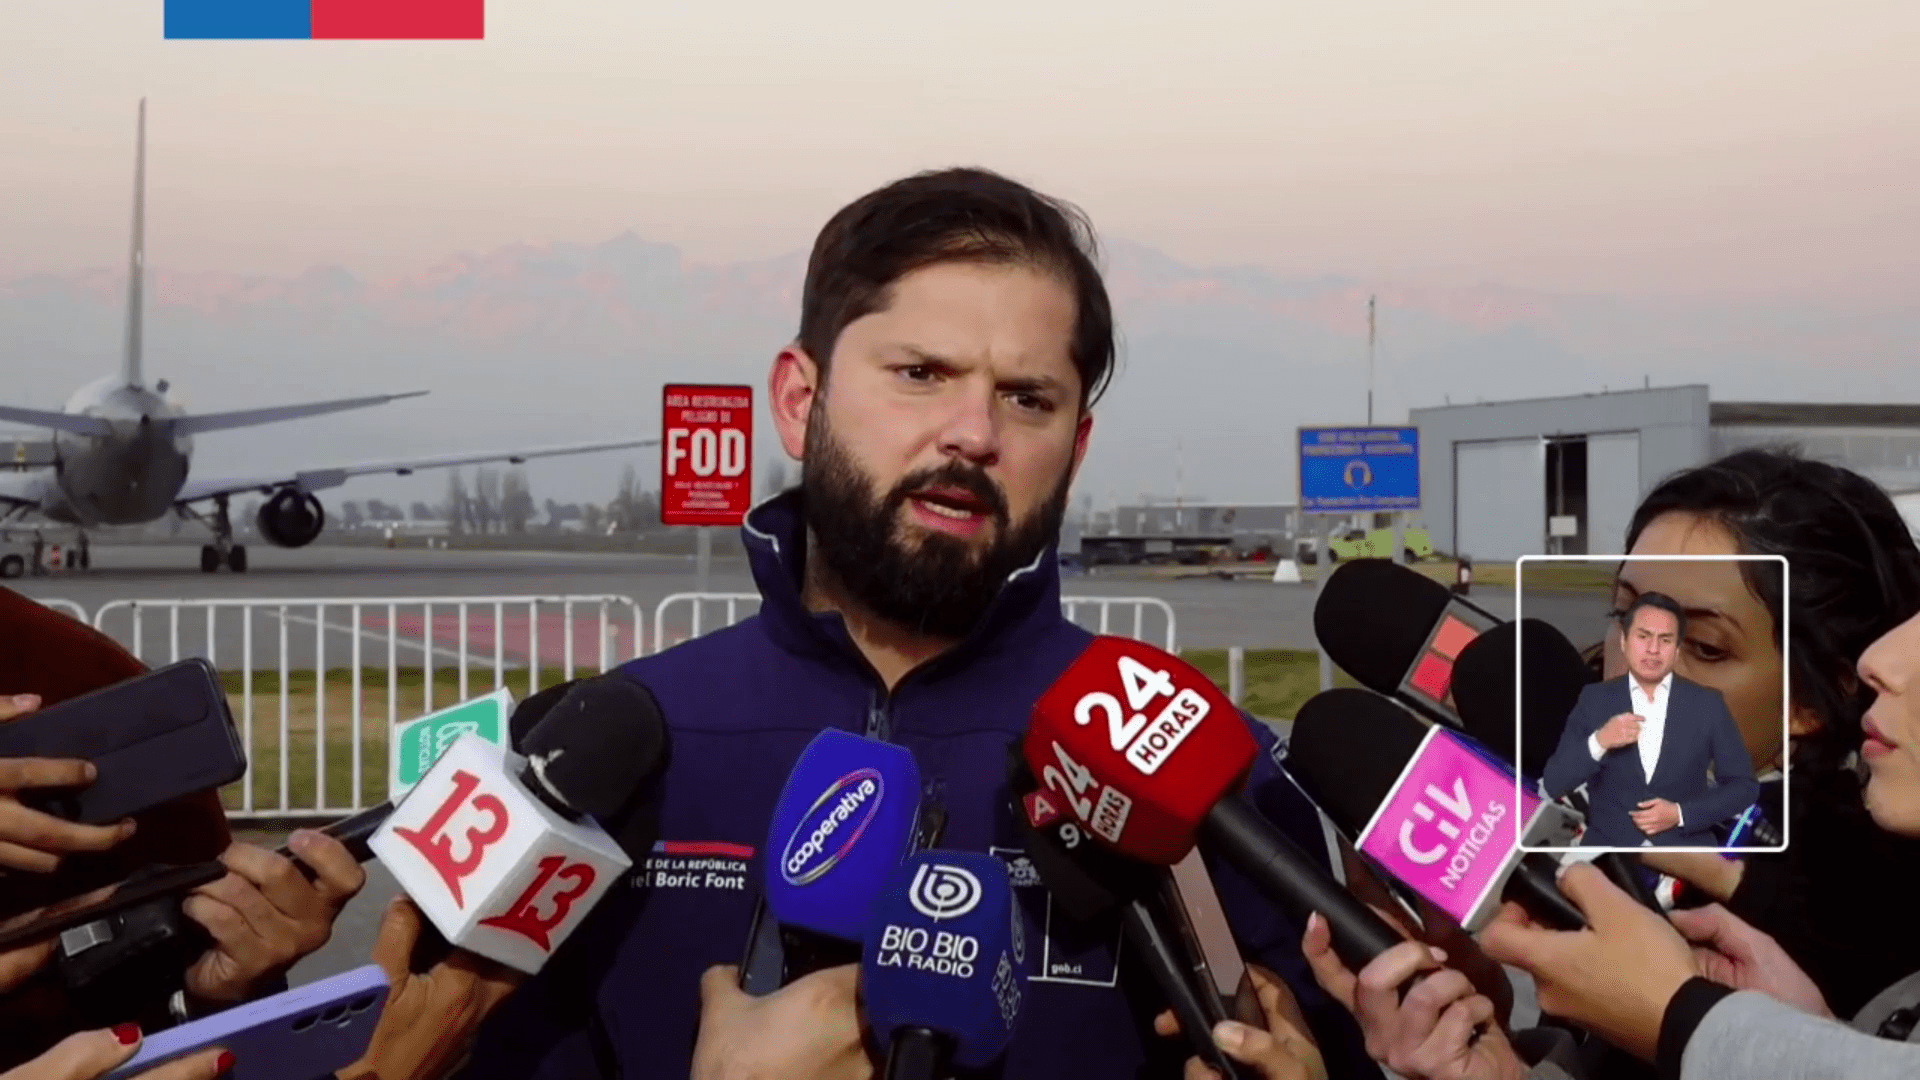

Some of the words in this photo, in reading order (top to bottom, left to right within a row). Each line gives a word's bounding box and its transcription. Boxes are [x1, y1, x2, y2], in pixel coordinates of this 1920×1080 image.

[667, 427, 746, 477] FOD
[1074, 655, 1176, 751] 24
[1134, 697, 1201, 766] HORAS
[1043, 740, 1099, 821] 24
[392, 769, 510, 910] 13
[787, 779, 876, 874] cooperativa
[1439, 800, 1507, 889] NOTICIAS
[655, 859, 669, 870] DE
[671, 860, 685, 870] LA
[688, 858, 748, 873] REPÚBLICA
[655, 871, 702, 888] Boric
[705, 873, 745, 890] Font
[477, 855, 596, 954] 13
[877, 951, 902, 968] LA
[907, 953, 974, 978] RADIO
[881, 924, 929, 953] BIO
[932, 930, 979, 962] BIO
